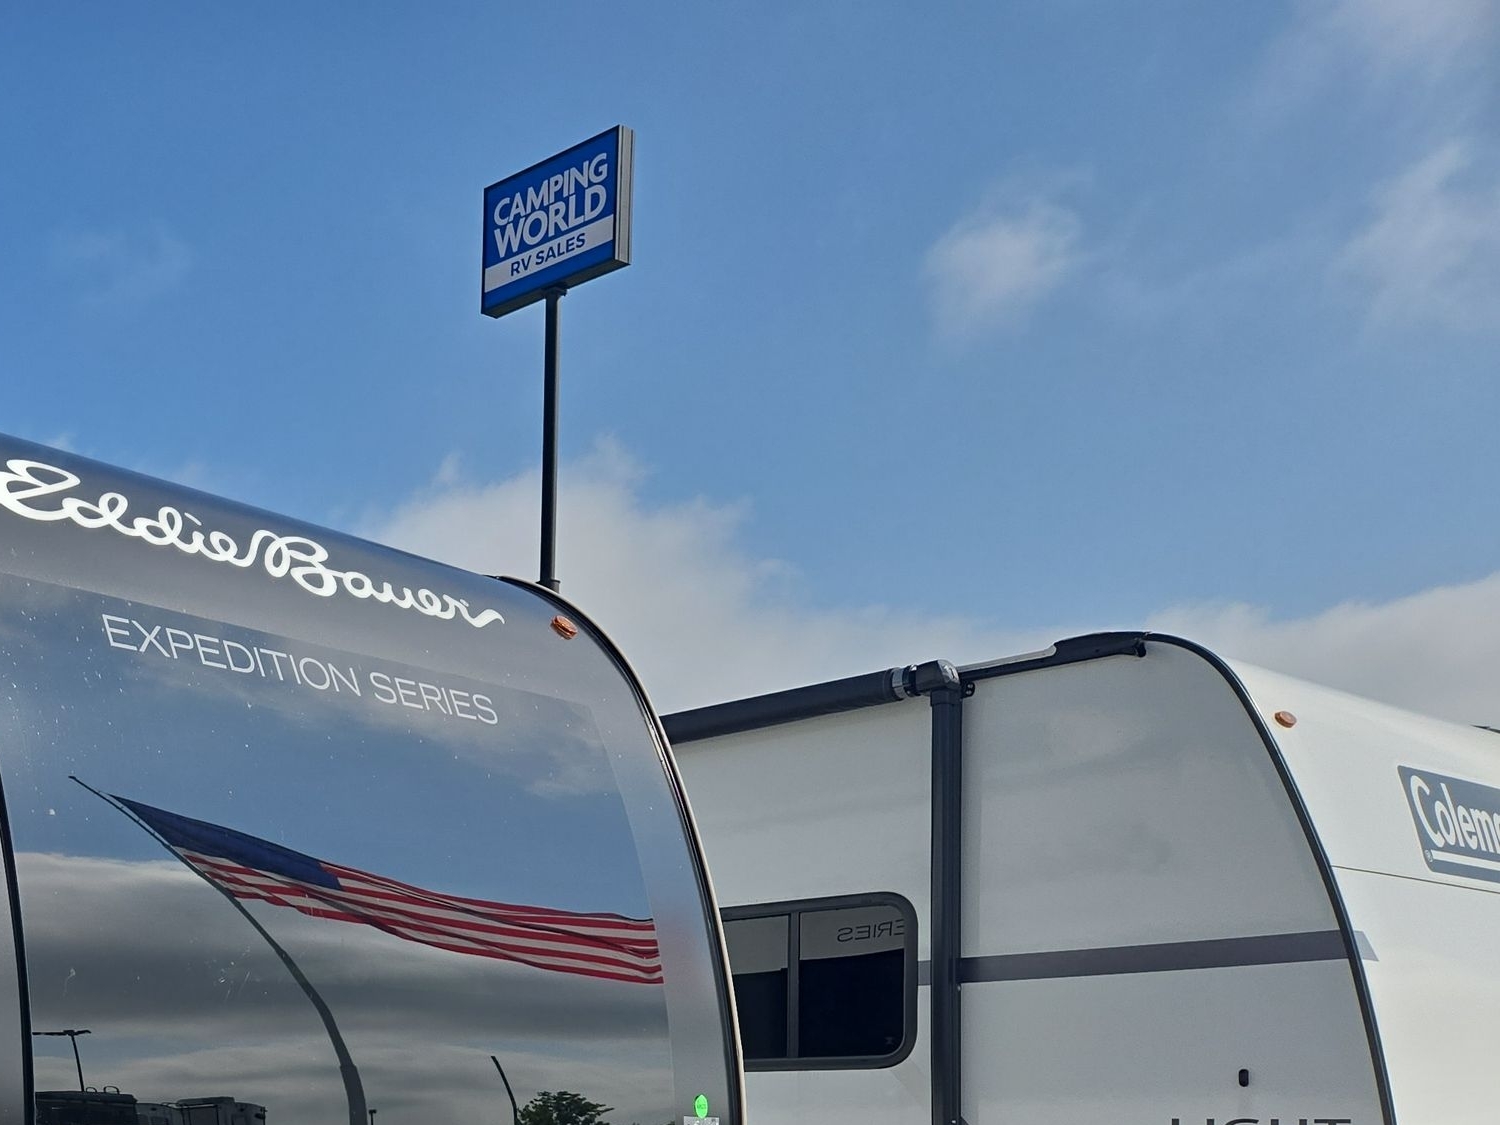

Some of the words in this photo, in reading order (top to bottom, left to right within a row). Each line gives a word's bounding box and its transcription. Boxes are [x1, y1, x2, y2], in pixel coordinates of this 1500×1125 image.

[493, 152, 608, 226] CAMPING
[493, 184, 607, 258] WORLD
[510, 254, 532, 277] RV
[535, 232, 586, 266] SALES
[250, 529, 505, 628] Bauer
[102, 613, 361, 698] EXPEDITION
[369, 671, 499, 726] SERIES
[1410, 774, 1500, 855] Colem
